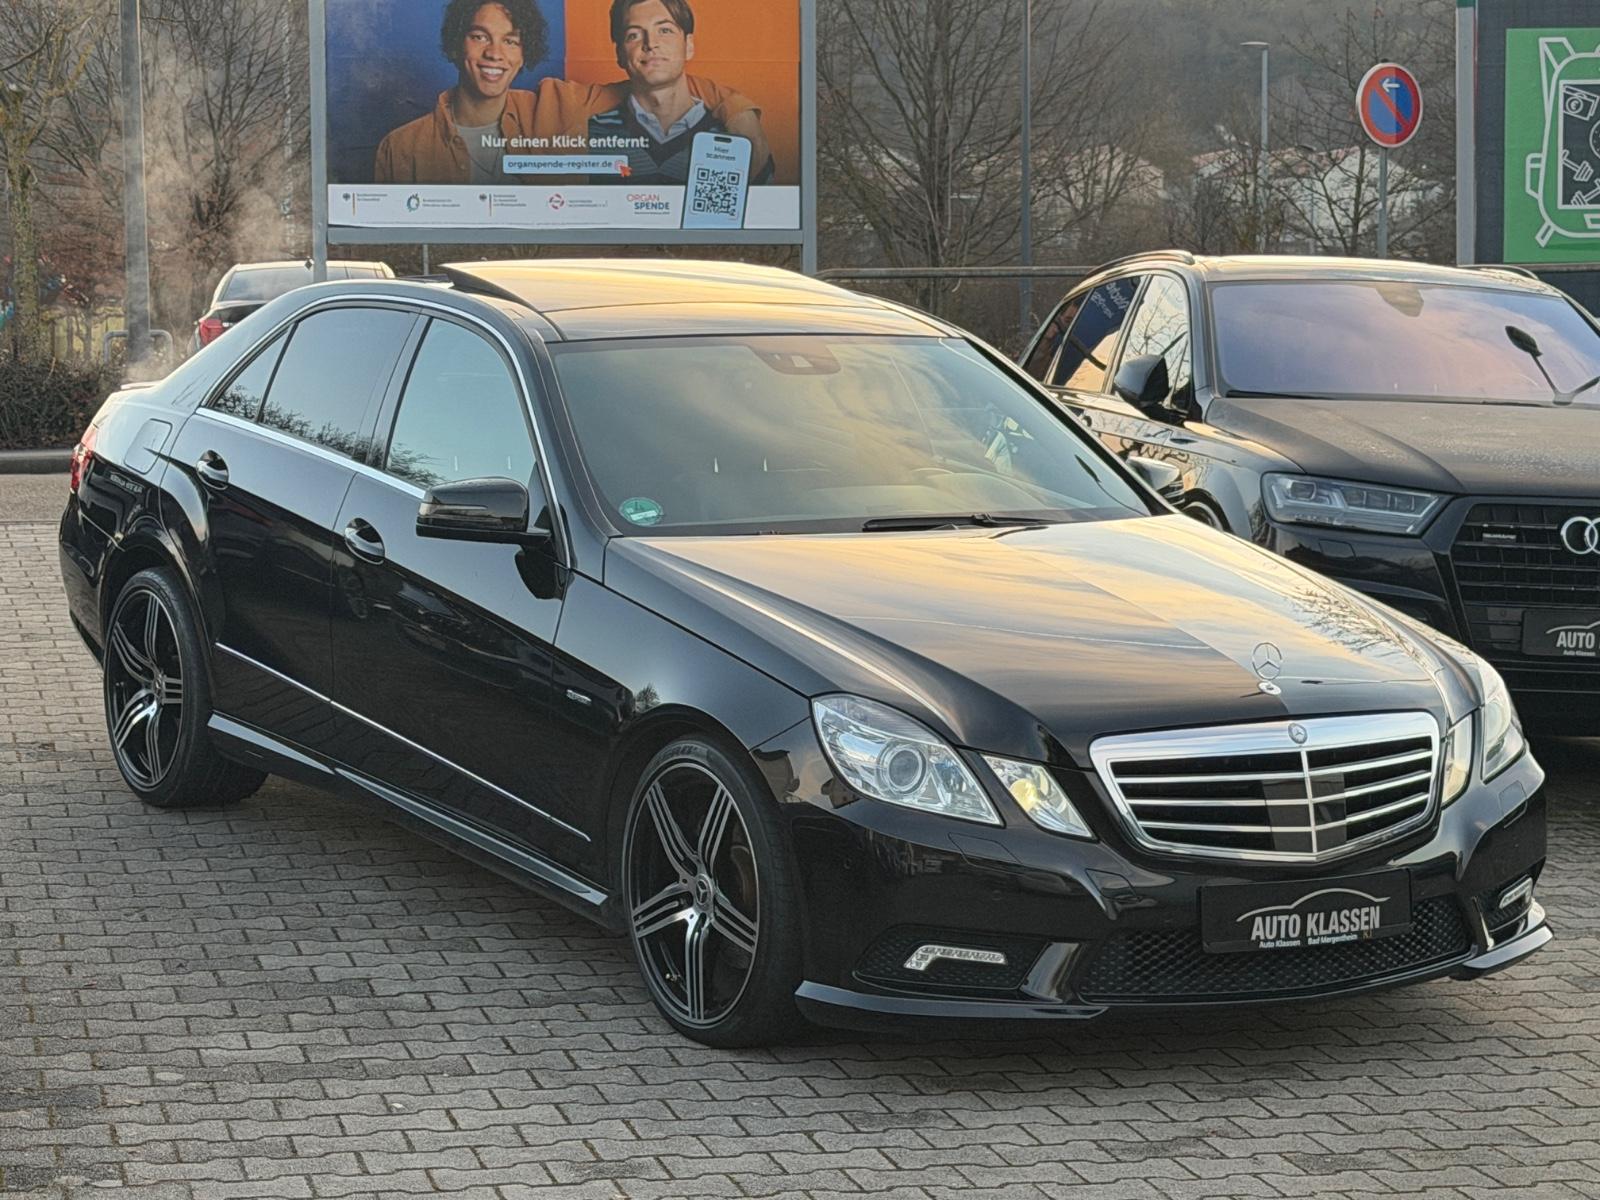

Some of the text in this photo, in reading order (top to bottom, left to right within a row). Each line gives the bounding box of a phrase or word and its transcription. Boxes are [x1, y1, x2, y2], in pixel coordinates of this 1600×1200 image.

[481, 134, 650, 149] Nur einen Klick entfernt:
[507, 160, 613, 170] organspende-register.de
[626, 193, 660, 202] ORGAN
[634, 201, 670, 210] SPENDE
[1556, 631, 1596, 649] AUTO
[1251, 905, 1380, 941] AUTO KLASSEN
[1259, 933, 1358, 949] Auto Klassen Bad Mergentheim
